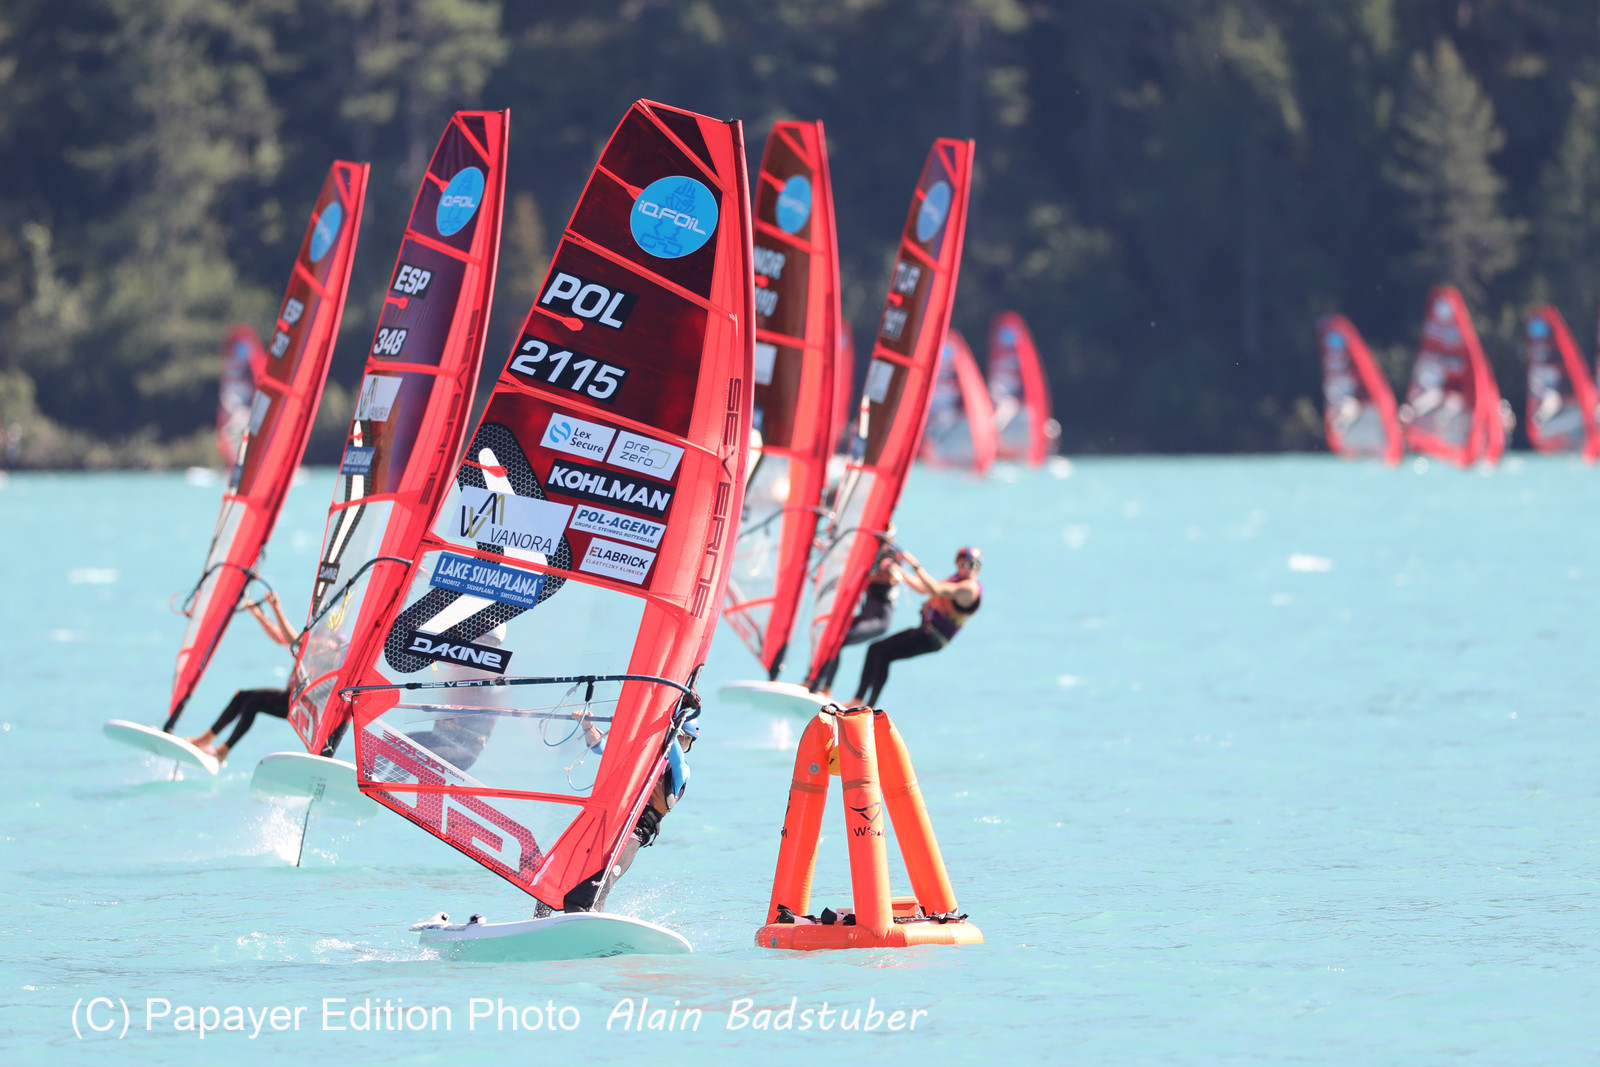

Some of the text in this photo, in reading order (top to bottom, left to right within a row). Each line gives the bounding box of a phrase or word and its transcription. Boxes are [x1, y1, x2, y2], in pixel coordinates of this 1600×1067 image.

[394, 264, 431, 295] ESP
[541, 272, 625, 328] POL
[373, 328, 407, 355] 348
[510, 340, 625, 399] 2115
[570, 437, 604, 454] Secure
[574, 427, 591, 439] Lex
[623, 440, 650, 453] pre
[620, 451, 654, 467] zero
[548, 466, 671, 511] KOHLMAN
[690, 378, 741, 619] SEVERNE
[577, 509, 661, 537] POL-AGENT
[490, 528, 554, 552] VANORA
[589, 546, 649, 570] ELABRICK
[438, 558, 537, 597] LAKE SILVAPLANA
[442, 578, 461, 587] MORITZ
[466, 583, 494, 595] SILVAPLANA
[500, 592, 533, 604] SWITZERLAND
